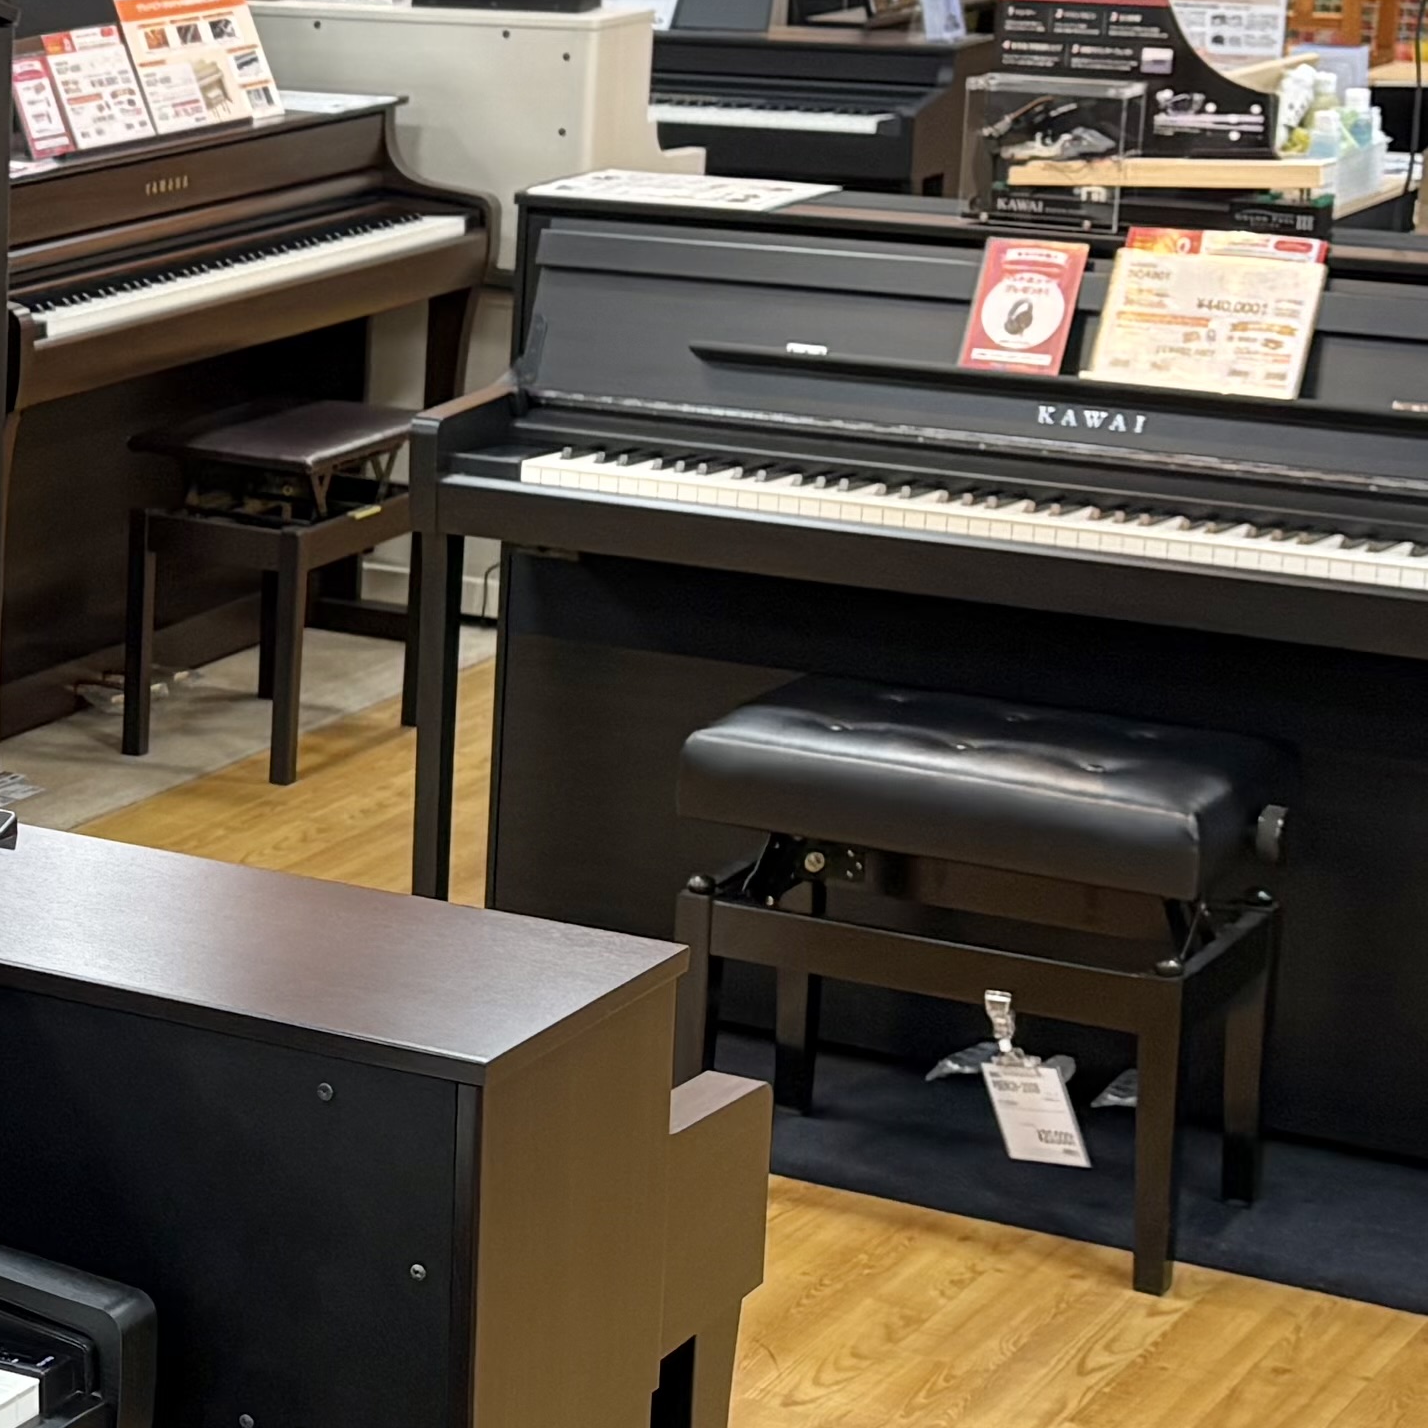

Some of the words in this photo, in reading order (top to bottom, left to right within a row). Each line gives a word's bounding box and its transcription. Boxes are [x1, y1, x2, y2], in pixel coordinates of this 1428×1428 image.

[145, 175, 190, 197] YAMAHA
[996, 197, 1044, 214] KAWAI
[1037, 405, 1148, 436] KAWAI
